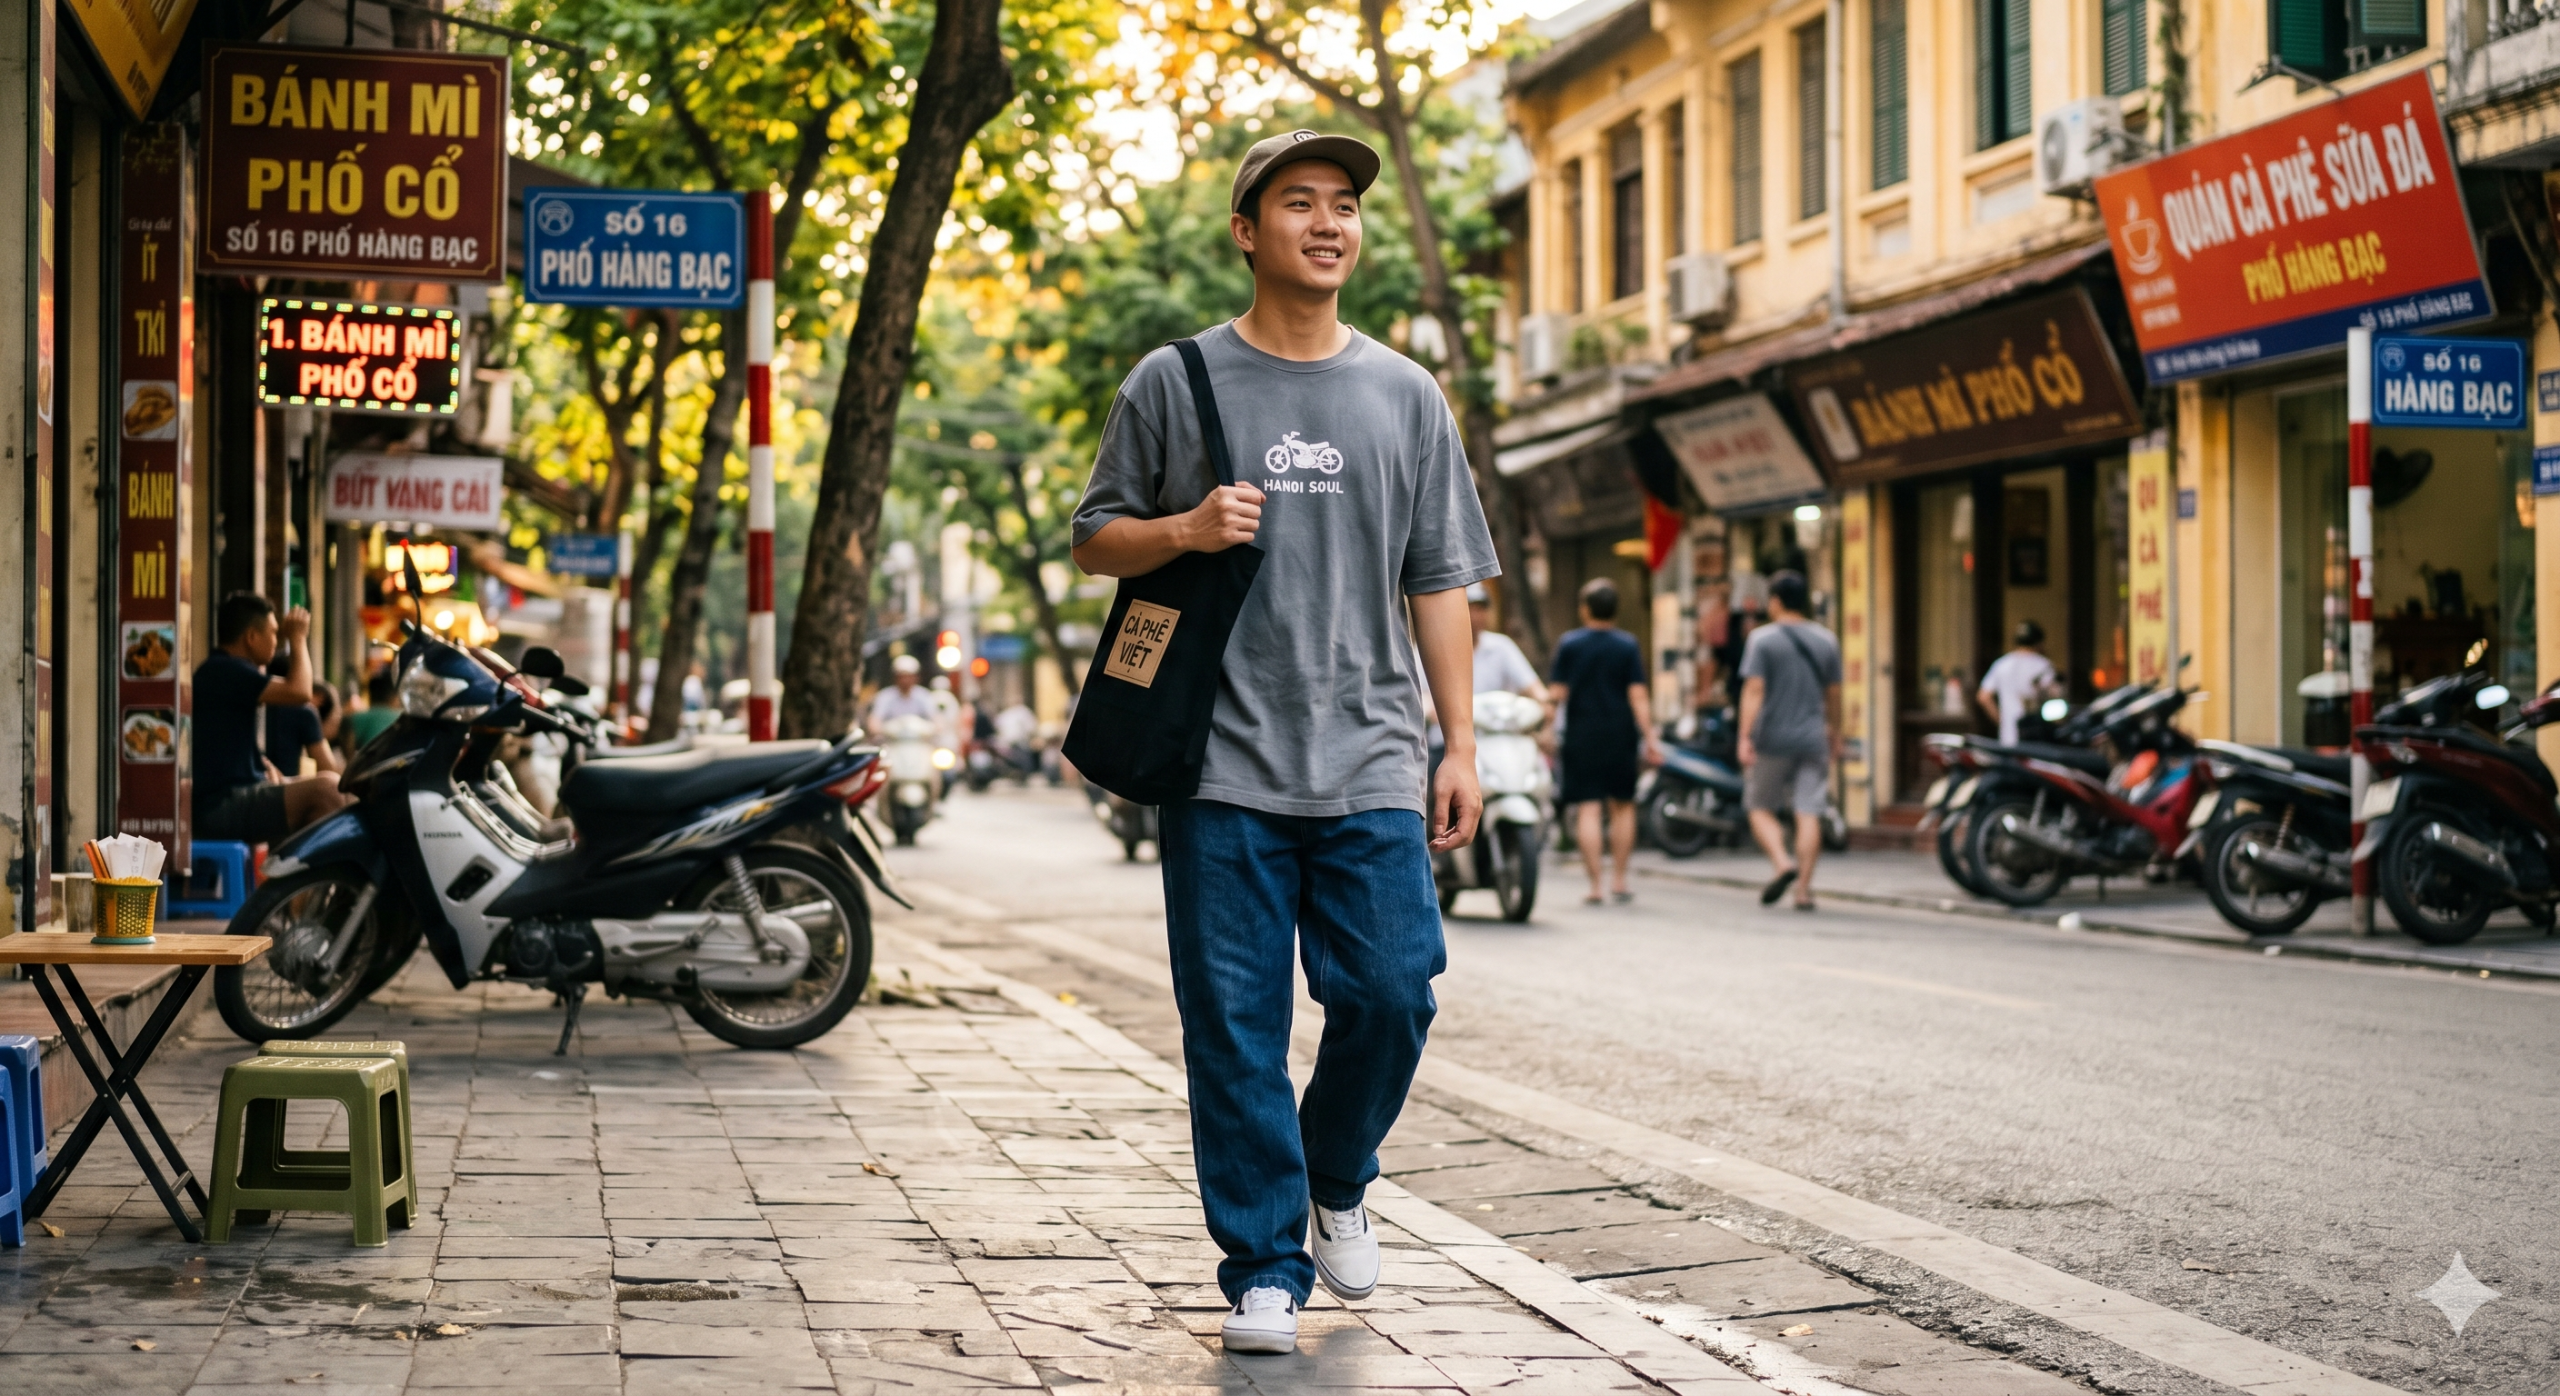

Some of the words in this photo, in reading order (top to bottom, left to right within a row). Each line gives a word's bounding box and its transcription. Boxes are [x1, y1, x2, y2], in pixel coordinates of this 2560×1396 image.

[230, 64, 390, 133] BÁNH
[409, 74, 481, 138] MÌ
[247, 142, 368, 216] PHỐ
[383, 144, 465, 220] CỔ
[2229, 153, 2275, 237] CÀ
[2265, 136, 2329, 227] PHÊ
[2381, 101, 2436, 194] ĐÁ
[226, 219, 261, 252] SỐ
[267, 228, 295, 254] 16
[302, 223, 353, 257] PHỐ
[358, 227, 424, 260] HÀNG
[430, 236, 479, 267] BẠC
[604, 201, 647, 236] SỐ
[653, 212, 688, 237] 16
[540, 236, 595, 287] PHỐ
[601, 241, 673, 289] HÀNG
[678, 252, 732, 299] BẠC
[2242, 241, 2286, 304] PHỐ
[2282, 240, 2343, 295] HÀNG
[2338, 230, 2388, 286] BẠC
[268, 317, 296, 350] 1.
[300, 313, 396, 356] BÁNH
[403, 319, 448, 360] MÌ
[298, 355, 369, 398] PHỐ
[371, 355, 418, 401] CỔ
[2031, 318, 2084, 411] CỔ
[2384, 371, 2455, 414] HÀNG
[2463, 381, 2513, 421] BẠC
[128, 461, 174, 520] BÁNH
[1264, 479, 1304, 494] HANOI
[1308, 480, 1344, 495] SOUL
[132, 540, 168, 599] MÌ
[1119, 640, 1153, 673] VIỆT
[1139, 618, 1170, 644] PHÊ
